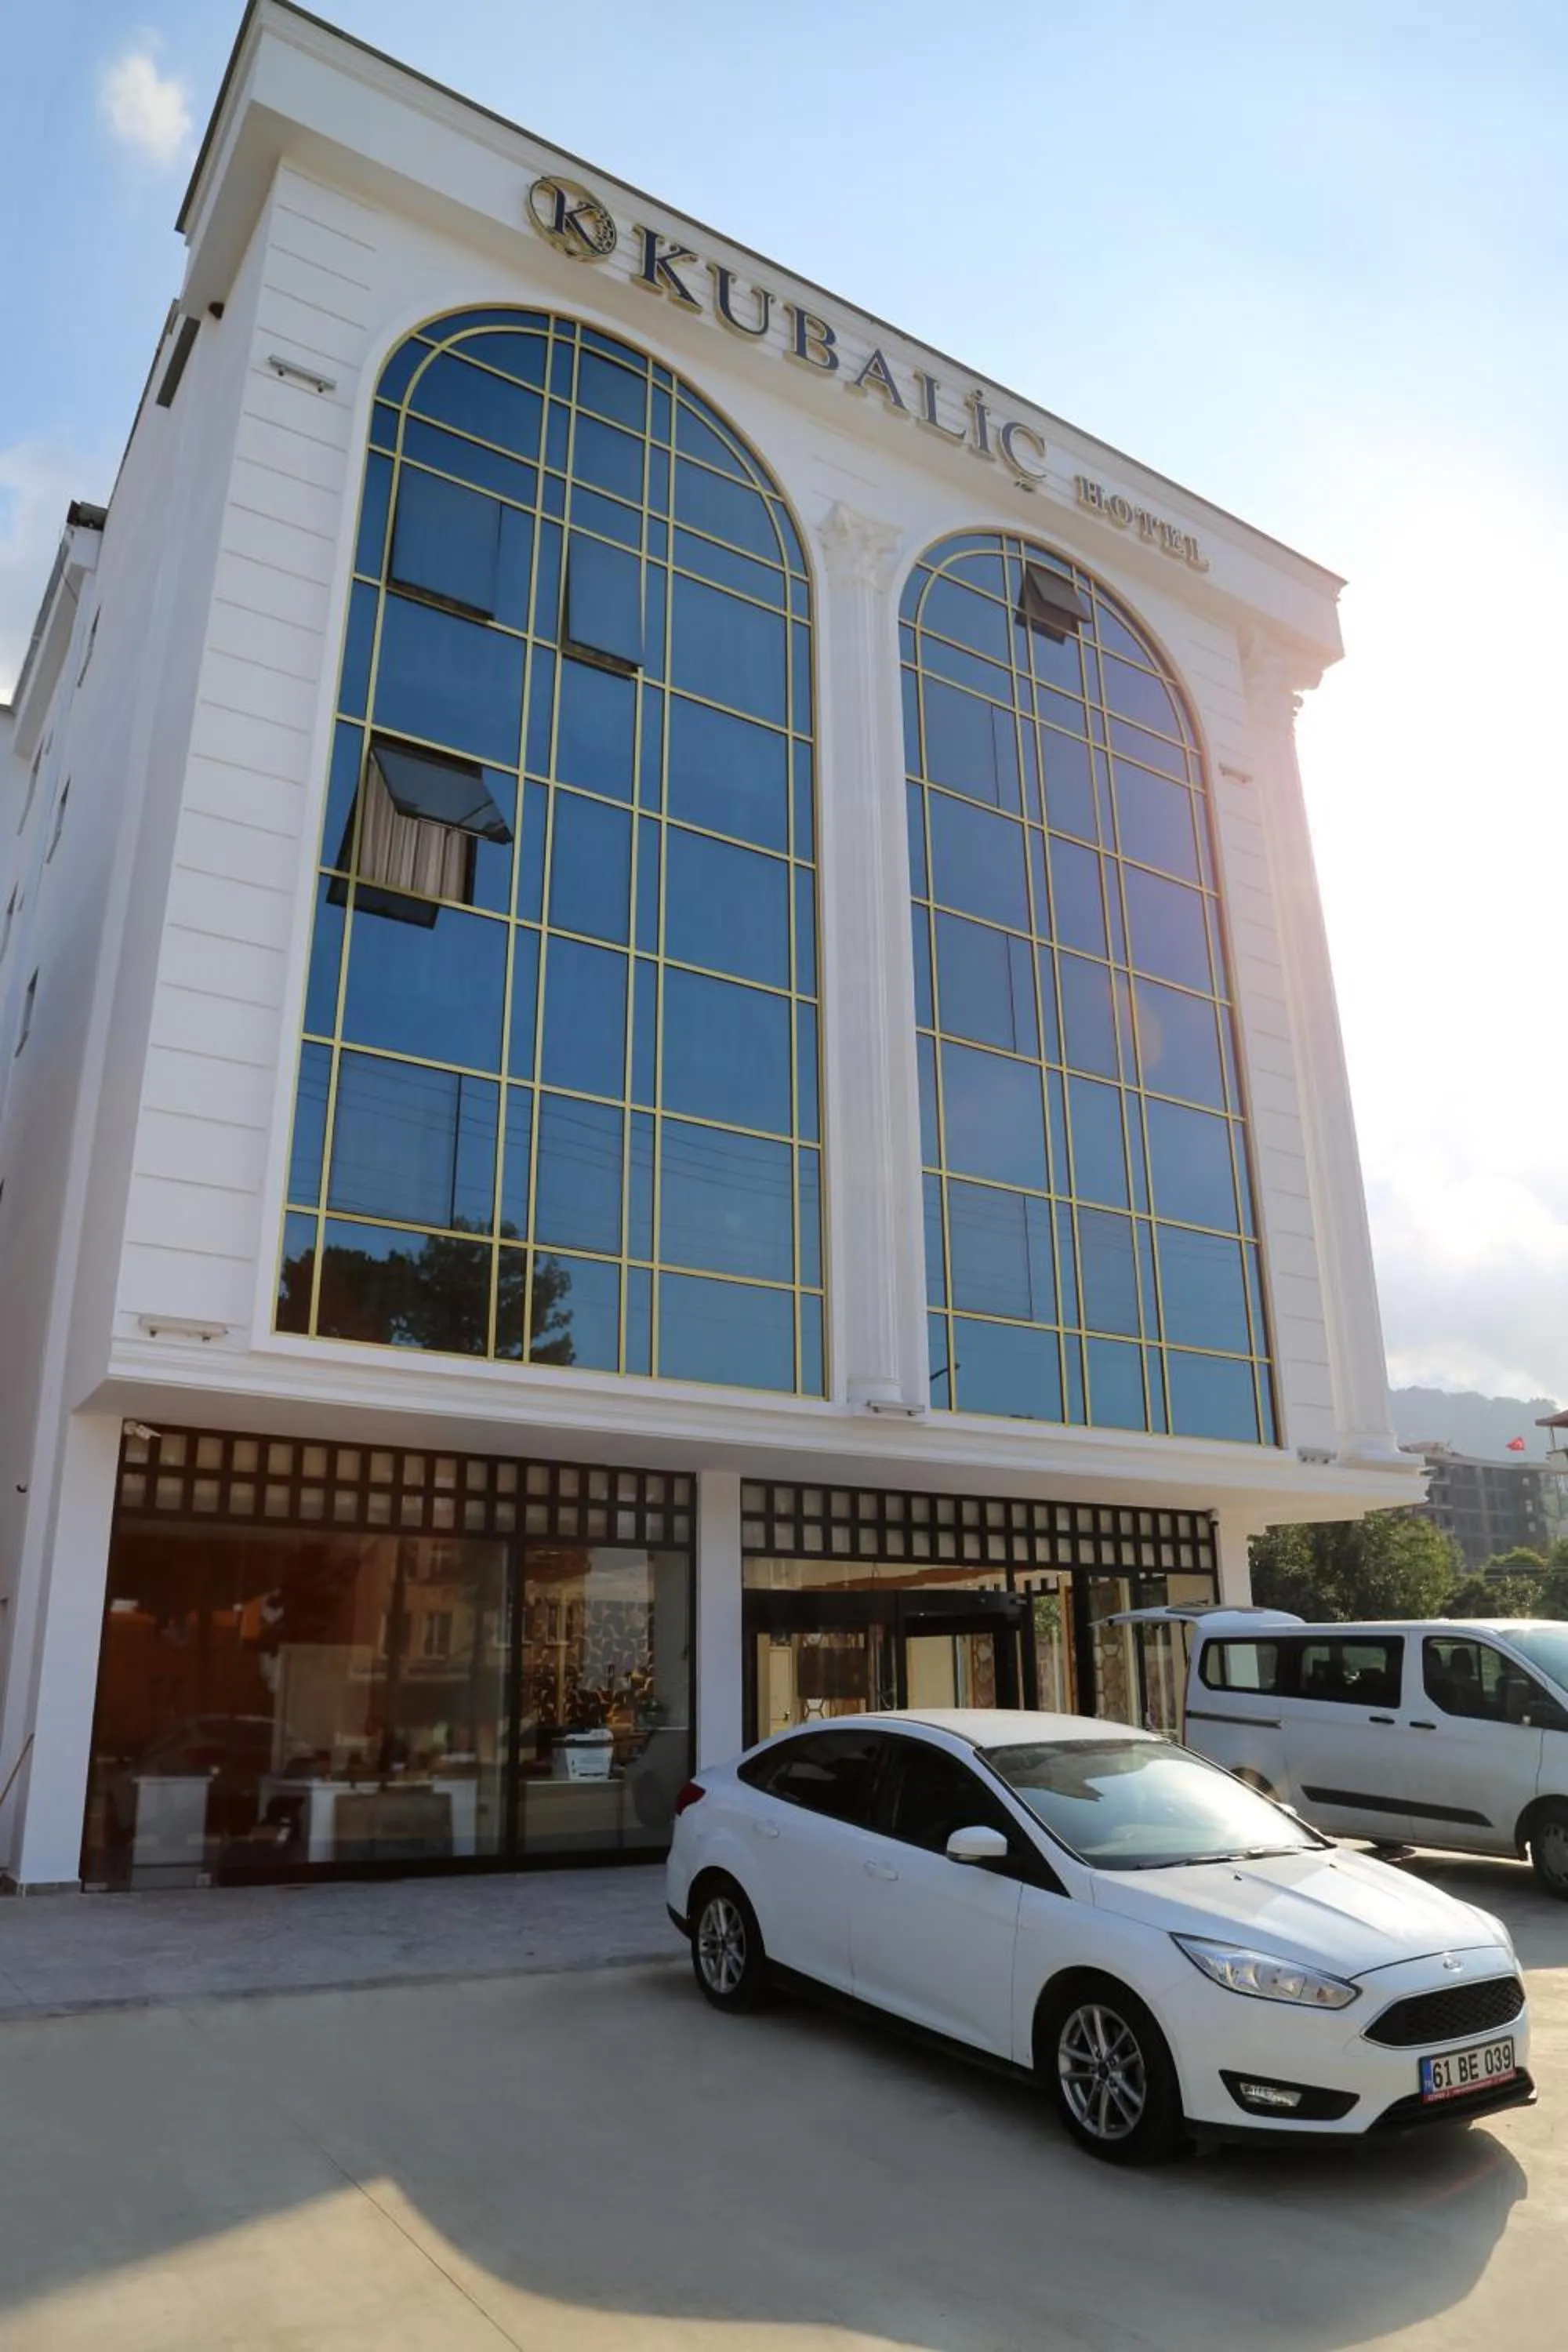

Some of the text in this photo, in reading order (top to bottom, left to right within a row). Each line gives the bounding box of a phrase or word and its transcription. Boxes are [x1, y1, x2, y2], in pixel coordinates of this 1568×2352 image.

[631, 223, 1210, 572] KUBALİÇ HOTEL
[1432, 2060, 1452, 2088] 61
[1458, 2053, 1479, 2082] BE
[1485, 2045, 1511, 2074] 039
